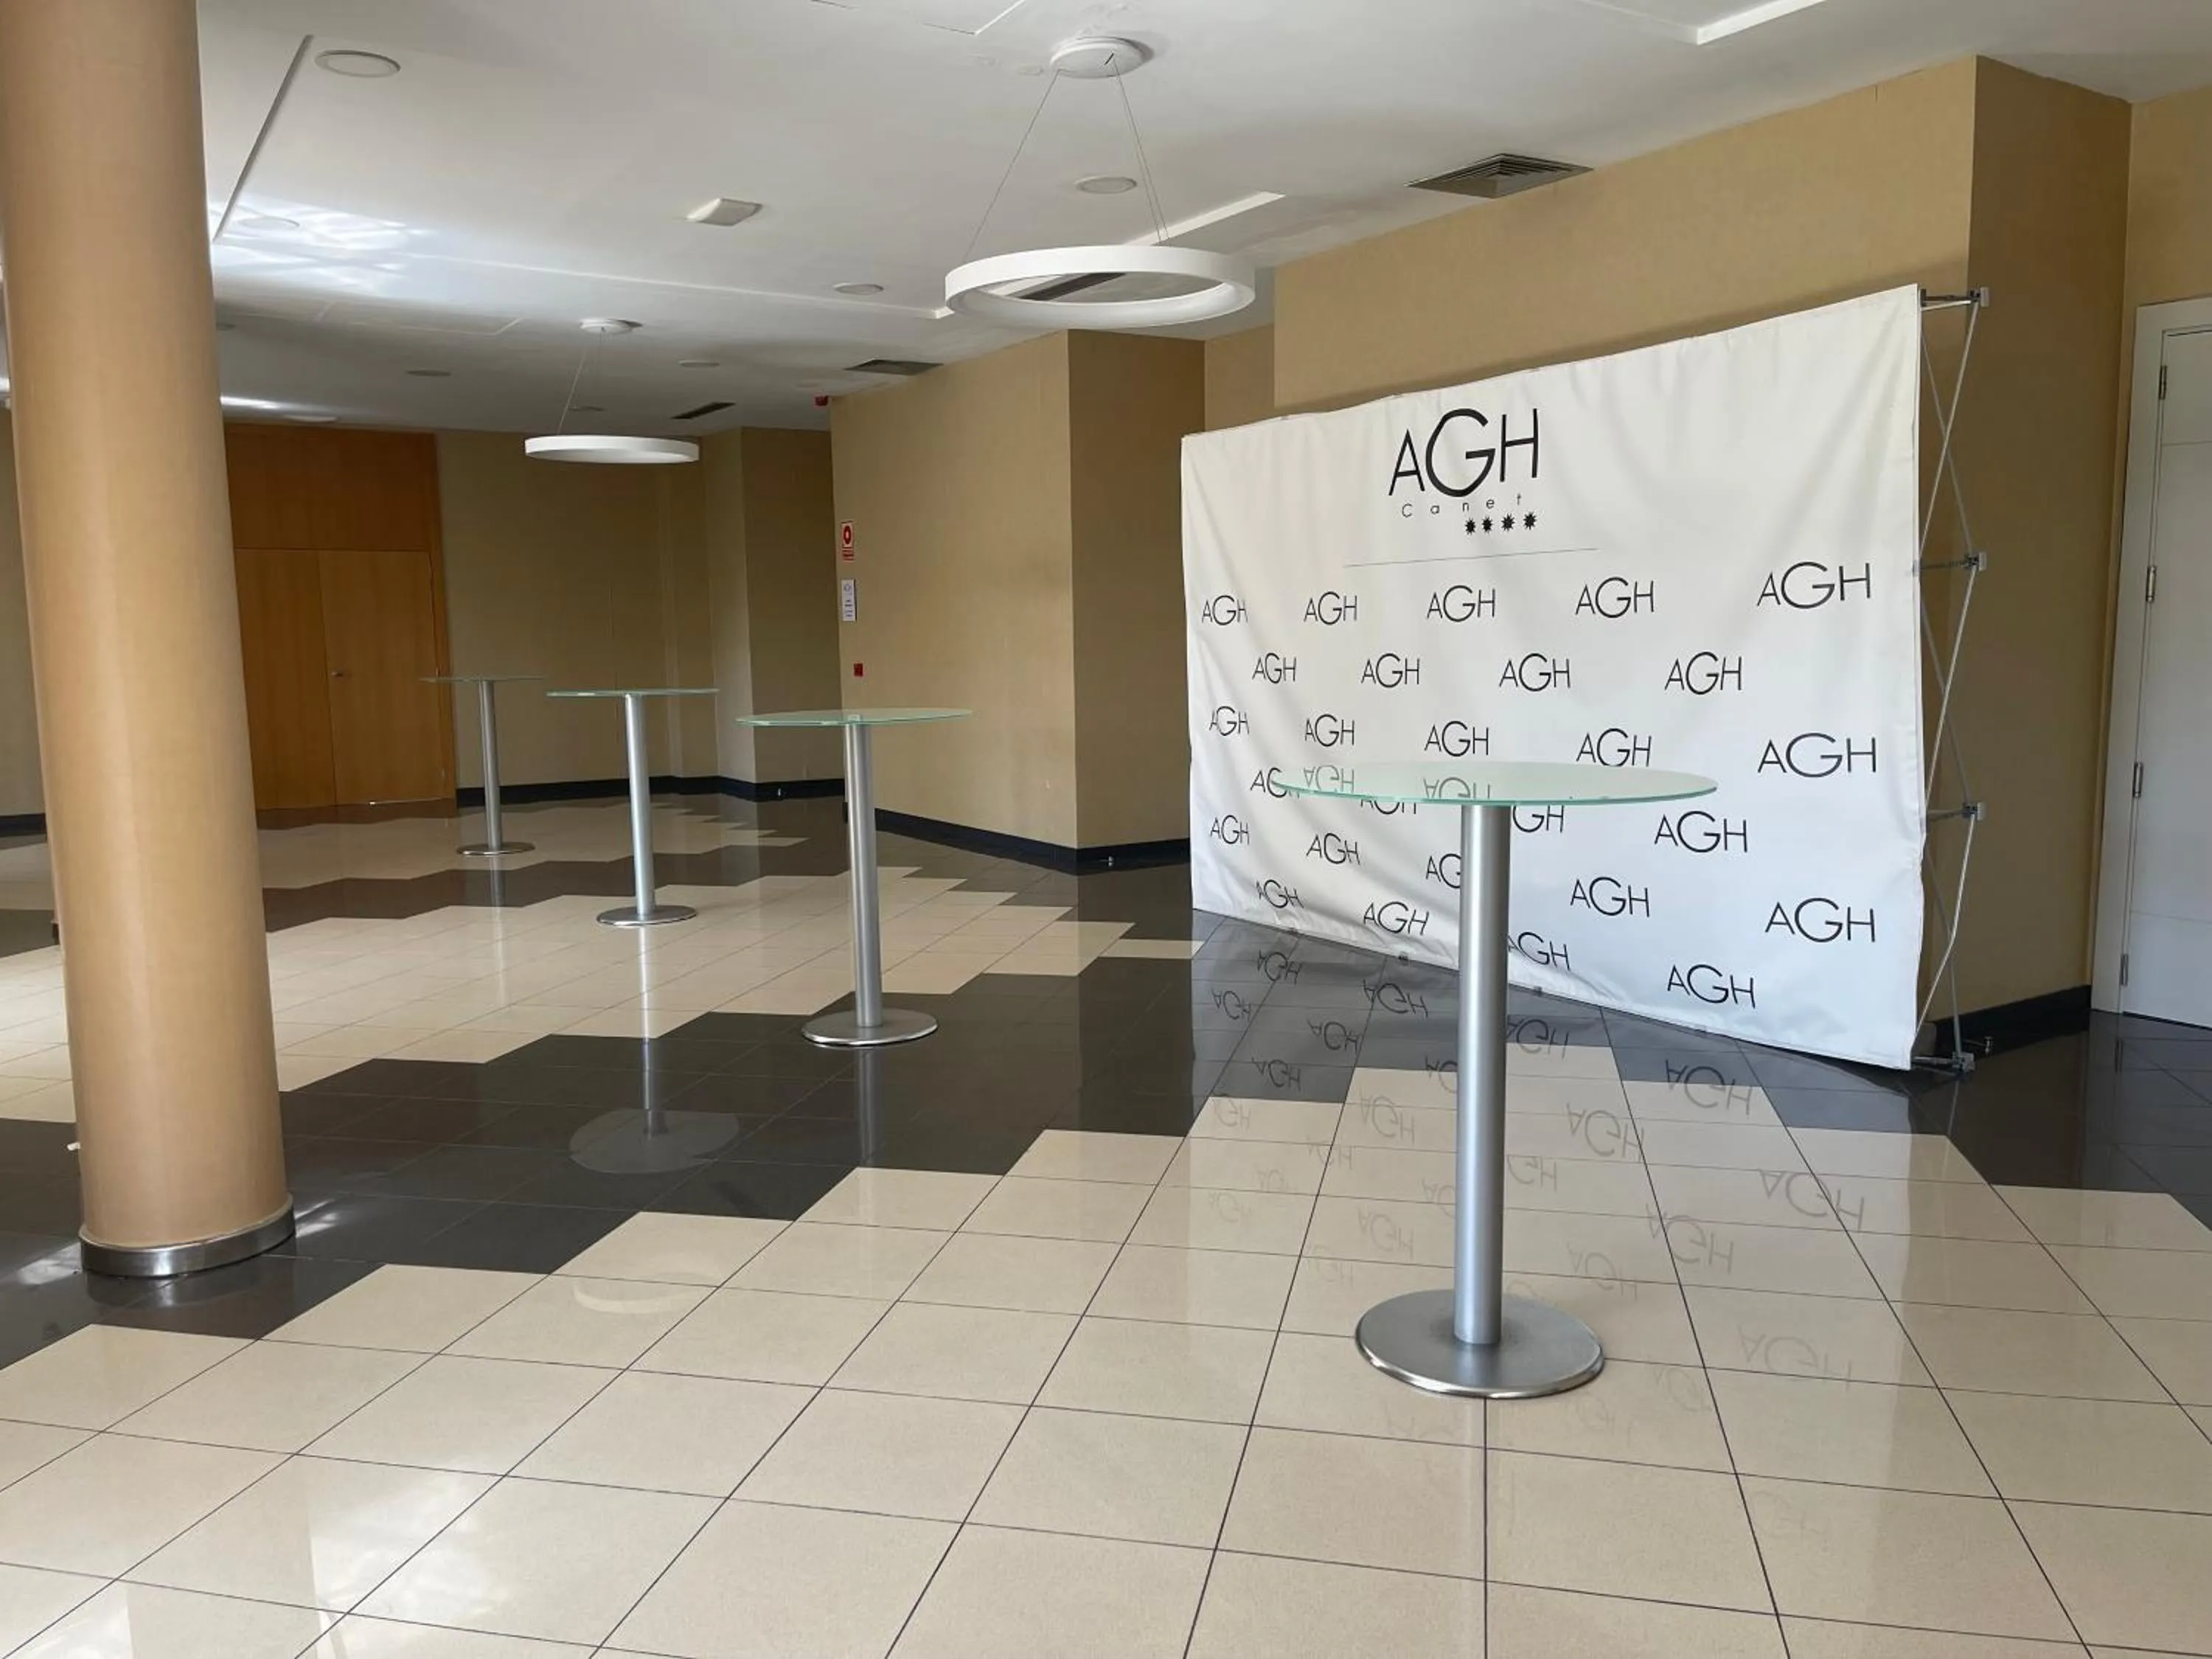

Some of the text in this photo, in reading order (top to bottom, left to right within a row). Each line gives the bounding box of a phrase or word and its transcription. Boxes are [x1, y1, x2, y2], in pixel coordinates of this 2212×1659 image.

[1388, 408, 1540, 497] AGH
[1402, 493, 1523, 518] Canet
[1575, 577, 1655, 618] AGH
[1756, 561, 1871, 609] AGH
[1202, 594, 1248, 625] AGH
[1304, 591, 1357, 625] AGH
[1427, 585, 1495, 622] AGH
[1252, 653, 1296, 684] AGH
[1361, 653, 1420, 688] AGH
[1499, 653, 1571, 692] AGH
[1665, 651, 1742, 695] AGH
[1209, 706, 1249, 736] AGH
[1304, 714, 1355, 747] AGH
[1425, 720, 1489, 757] AGH
[1576, 728, 1652, 767] AGH
[1758, 732, 1877, 778] AGH
[1210, 815, 1250, 844] AGH
[1512, 805, 1564, 832] GH
[1655, 810, 1747, 853] AGH
[1306, 833, 1360, 864] AGH
[1426, 854, 1461, 888] AG
[1256, 880, 1304, 908] AGH
[1570, 876, 1650, 917] AGH
[1363, 902, 1430, 936] AGH
[1764, 897, 1876, 943] AGH
[1667, 964, 1756, 1009] AGH
